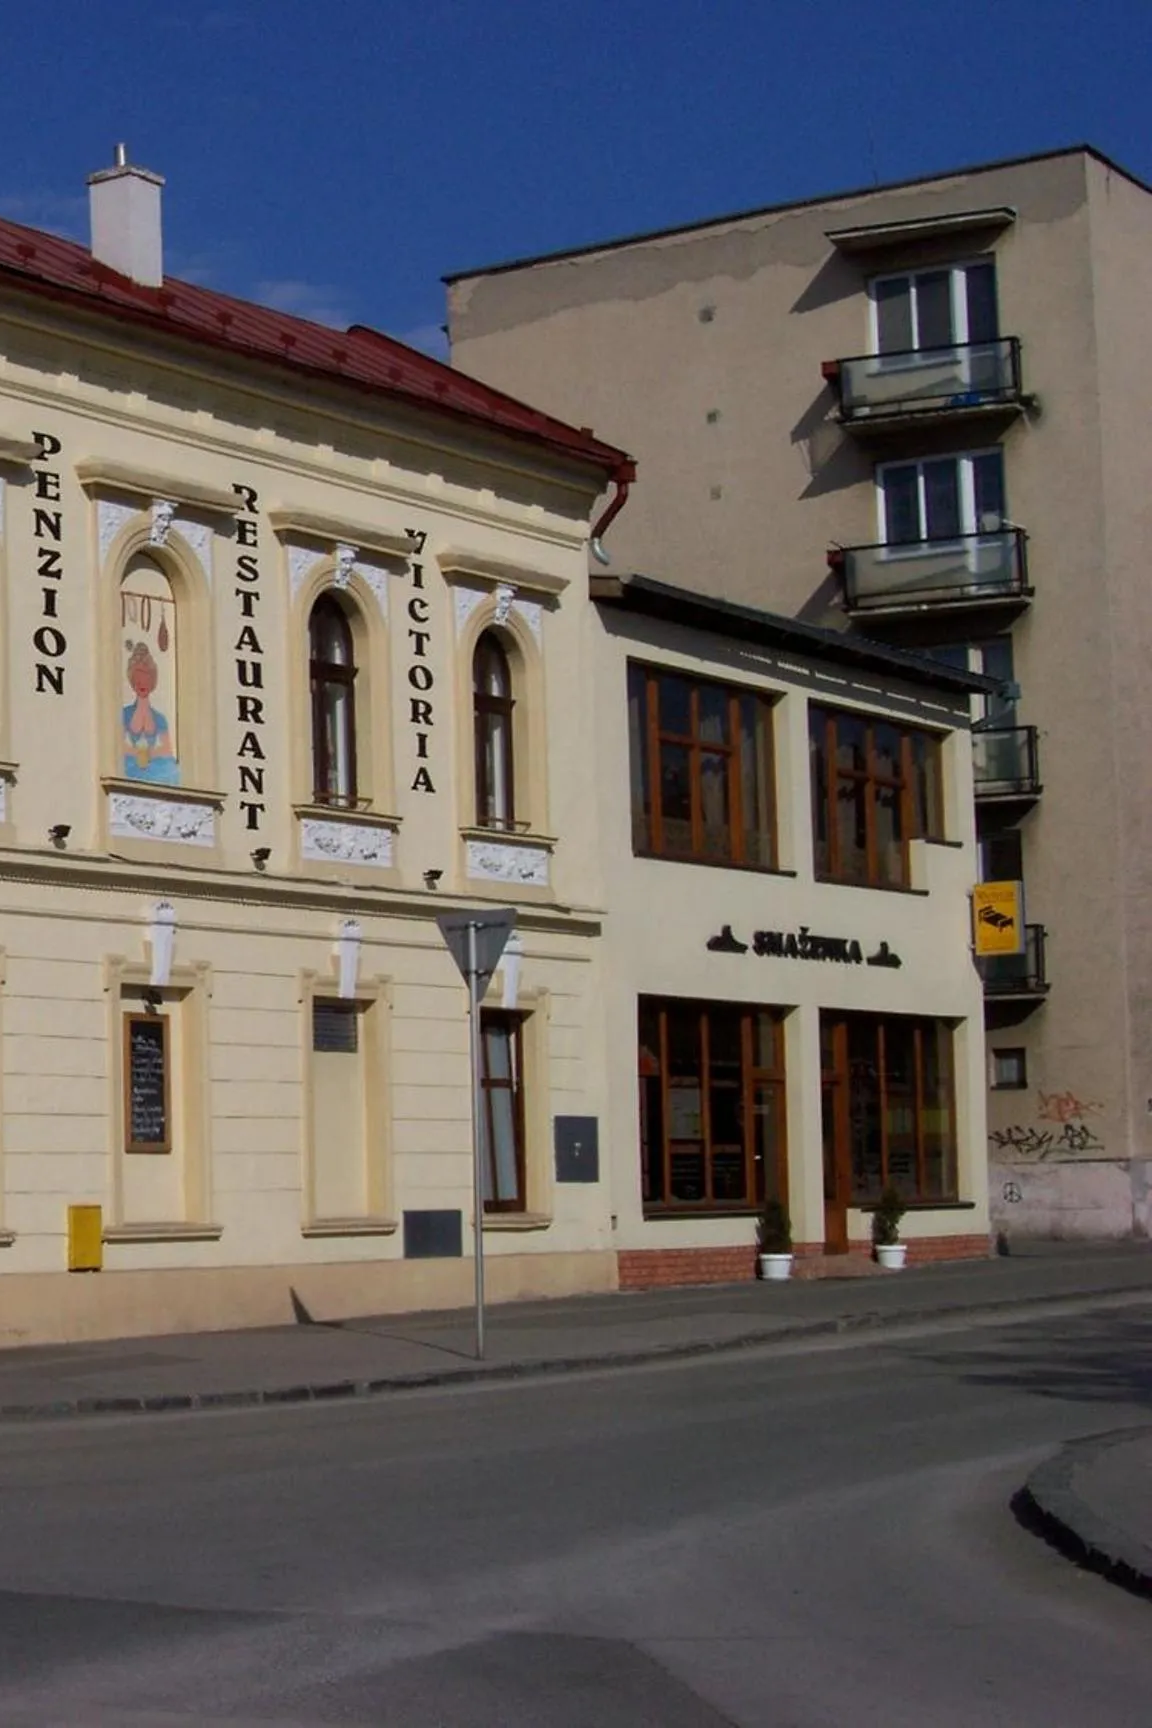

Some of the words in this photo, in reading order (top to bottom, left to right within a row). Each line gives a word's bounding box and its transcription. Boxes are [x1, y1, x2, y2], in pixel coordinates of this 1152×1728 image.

[32, 431, 66, 695] PENZION
[232, 483, 266, 831] RESTAURANT
[404, 528, 436, 793] VICTORIA
